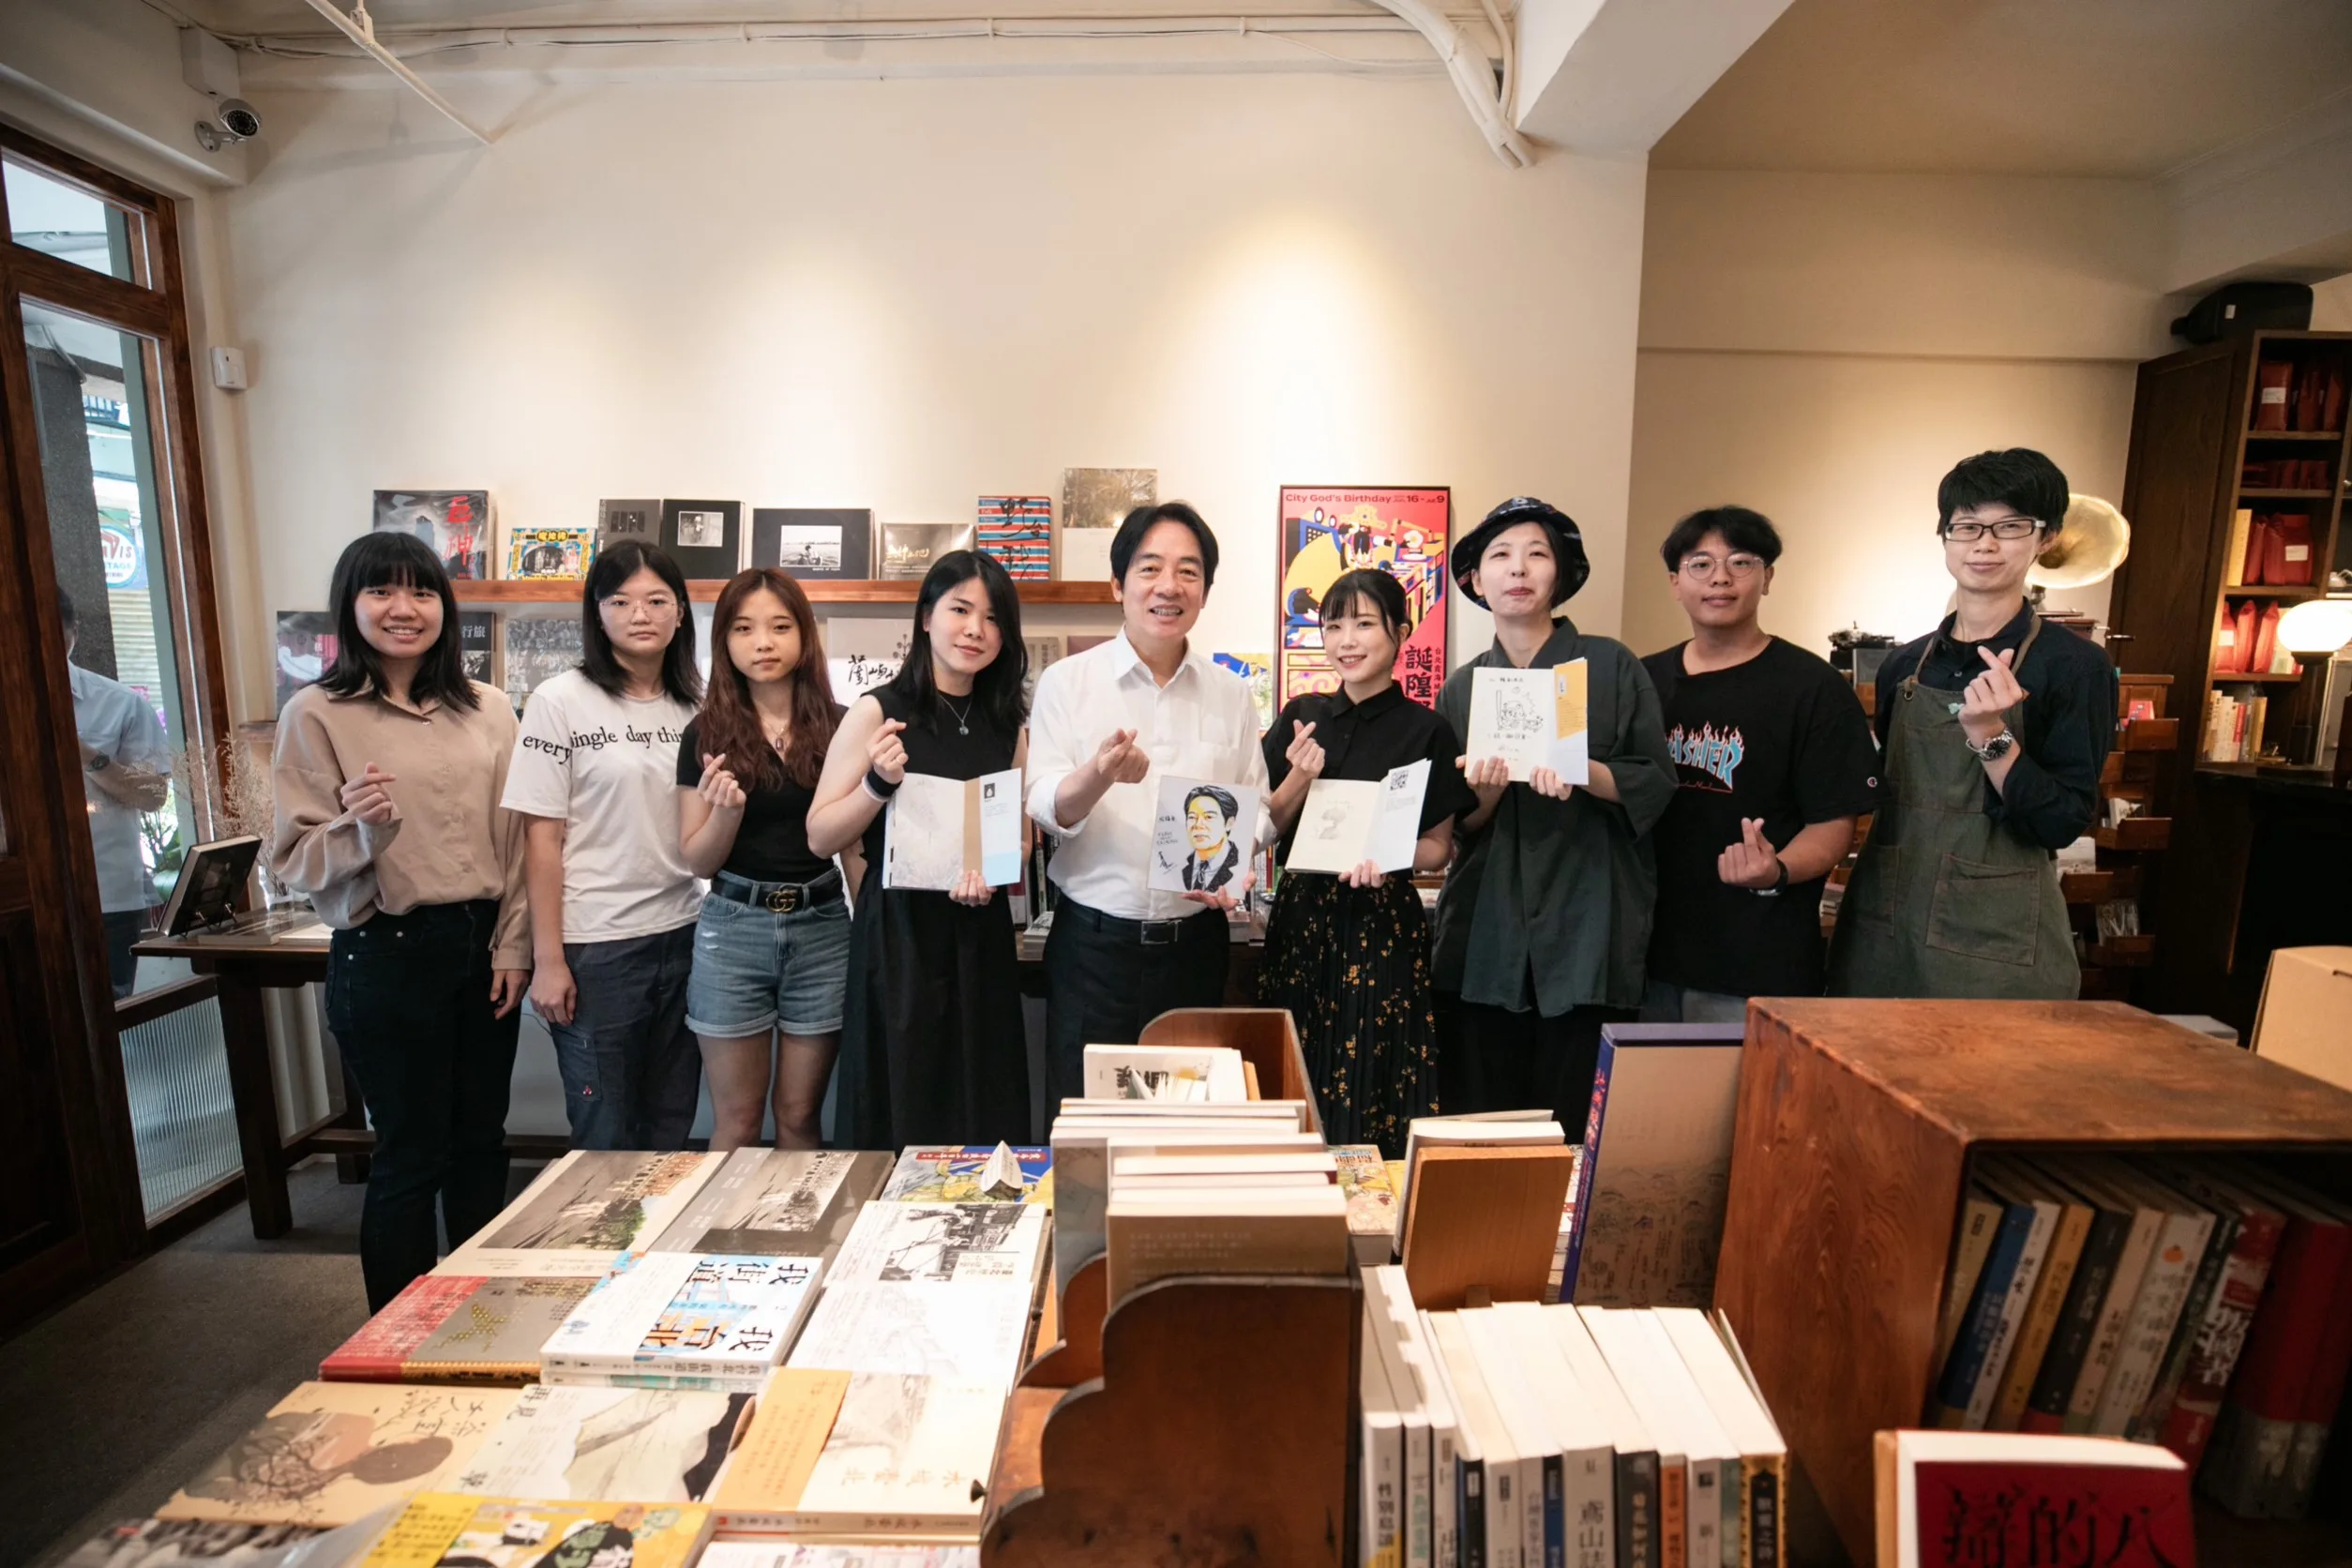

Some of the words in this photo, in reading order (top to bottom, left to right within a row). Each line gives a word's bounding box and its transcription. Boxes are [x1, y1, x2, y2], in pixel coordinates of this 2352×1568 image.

[1286, 493, 1307, 505] City
[1310, 493, 1341, 503] God's
[1344, 493, 1392, 504] Birthday
[1438, 494, 1446, 504] 9
[522, 735, 573, 765] every
[626, 725, 653, 749] day
[1667, 721, 1745, 789] ASHER
[685, 1259, 810, 1286] 我街道
[639, 1323, 774, 1351] 我台北
